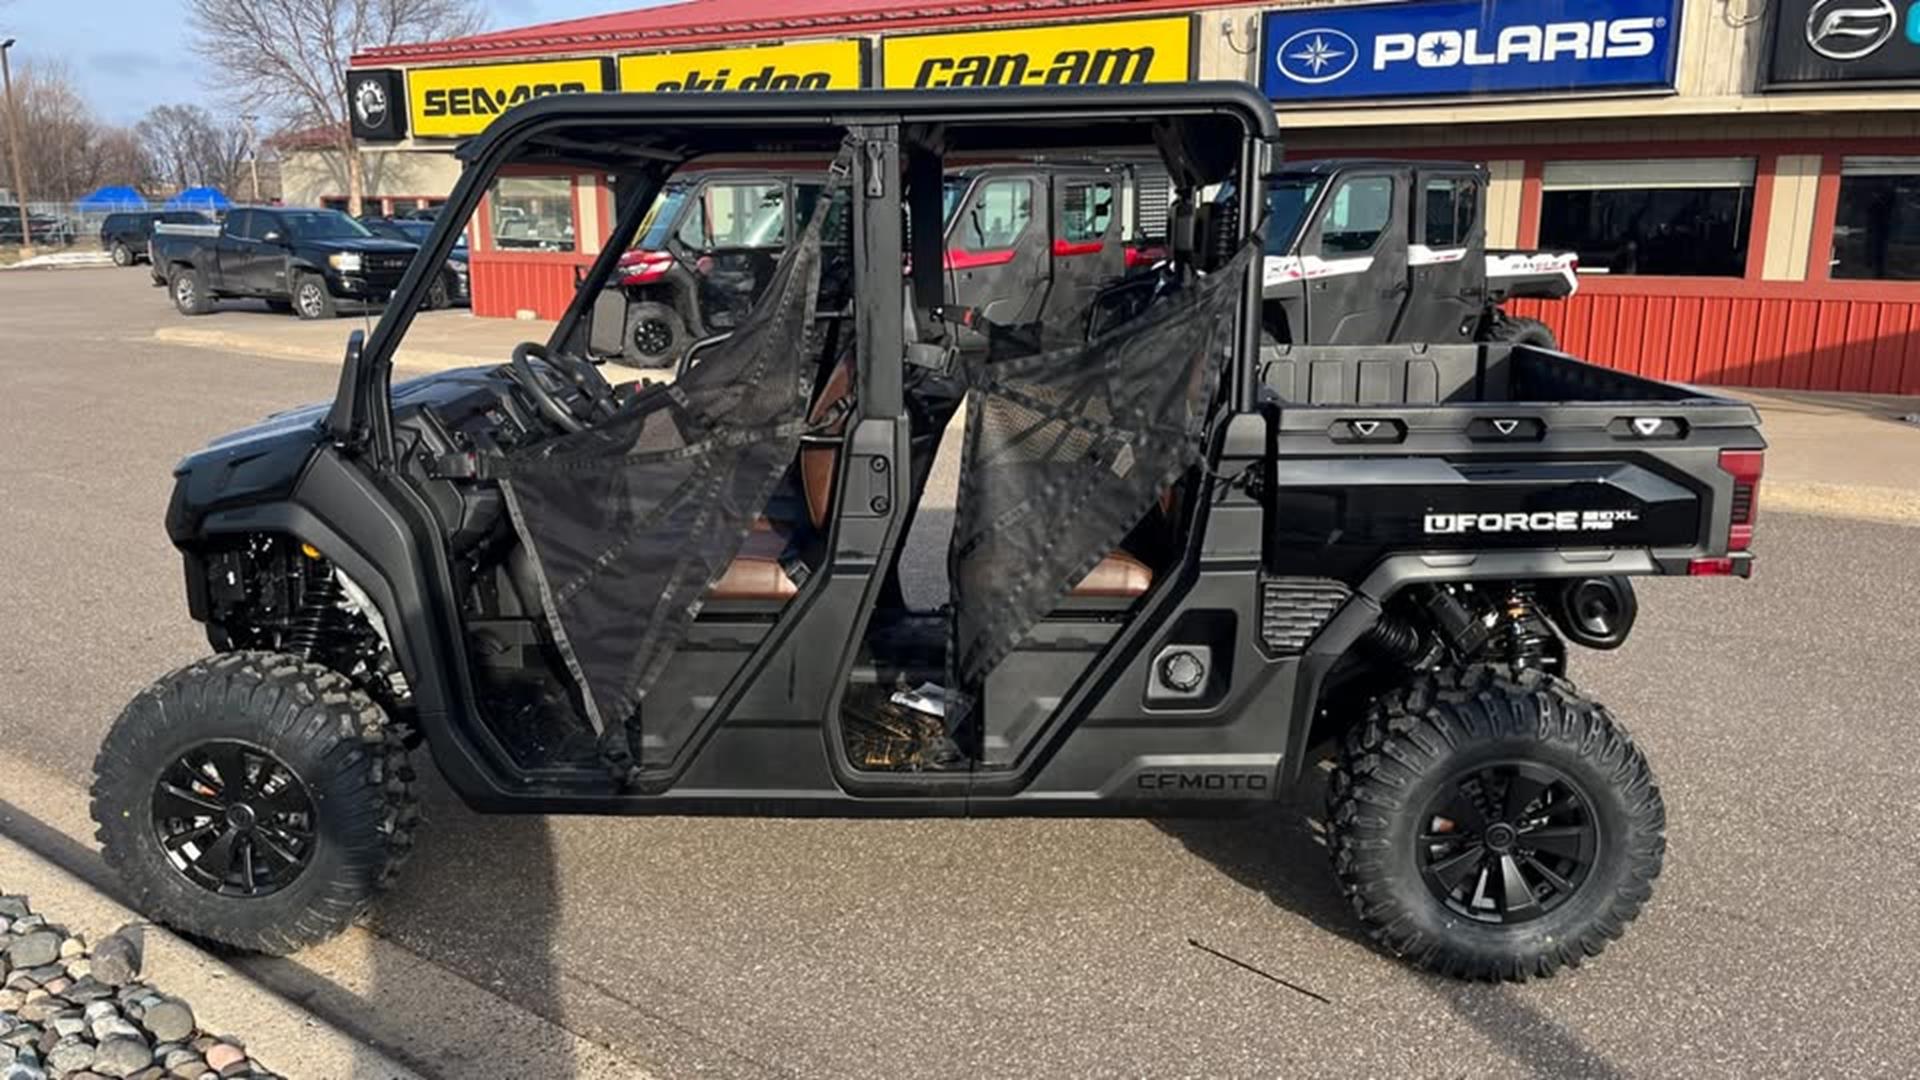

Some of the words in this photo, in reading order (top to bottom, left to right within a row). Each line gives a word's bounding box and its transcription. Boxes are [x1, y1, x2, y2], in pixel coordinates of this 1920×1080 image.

[914, 46, 1155, 88] can-am
[1424, 511, 1579, 533] UFORCE
[1137, 773, 1267, 790] CFMOTO
